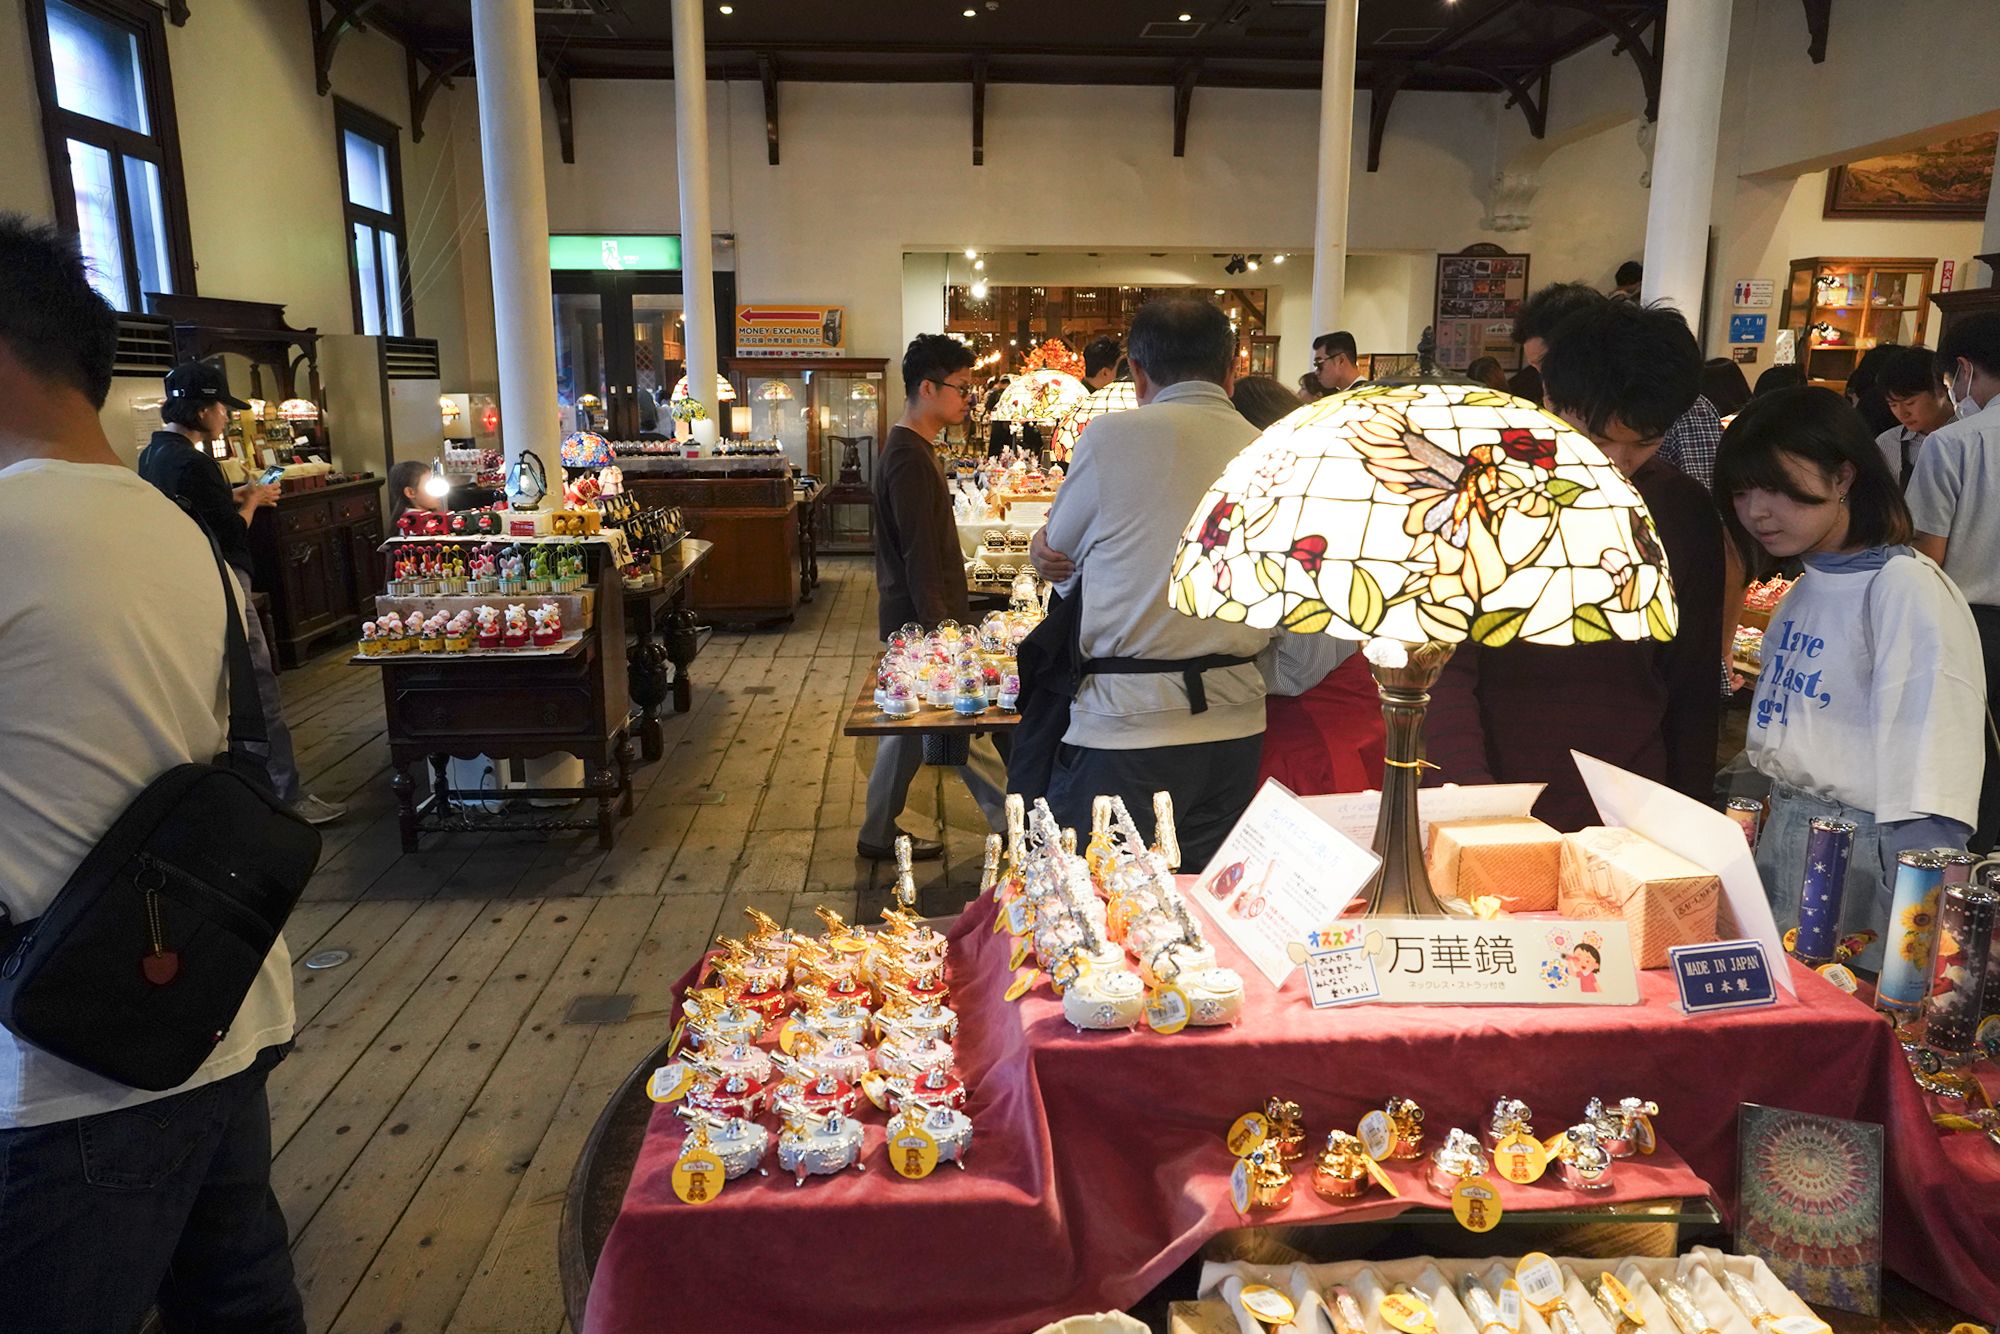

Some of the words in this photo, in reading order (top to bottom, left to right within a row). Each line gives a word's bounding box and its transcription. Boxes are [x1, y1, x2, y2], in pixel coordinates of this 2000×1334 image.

[739, 327, 770, 335] MONEY
[772, 327, 820, 335] EXCHANGE
[1386, 934, 1517, 975] 万華鏡
[1684, 961, 1711, 977] MADE
[1713, 958, 1728, 973] IN
[1730, 954, 1761, 972] JAPAN
[1704, 978, 1751, 994] 日本製
